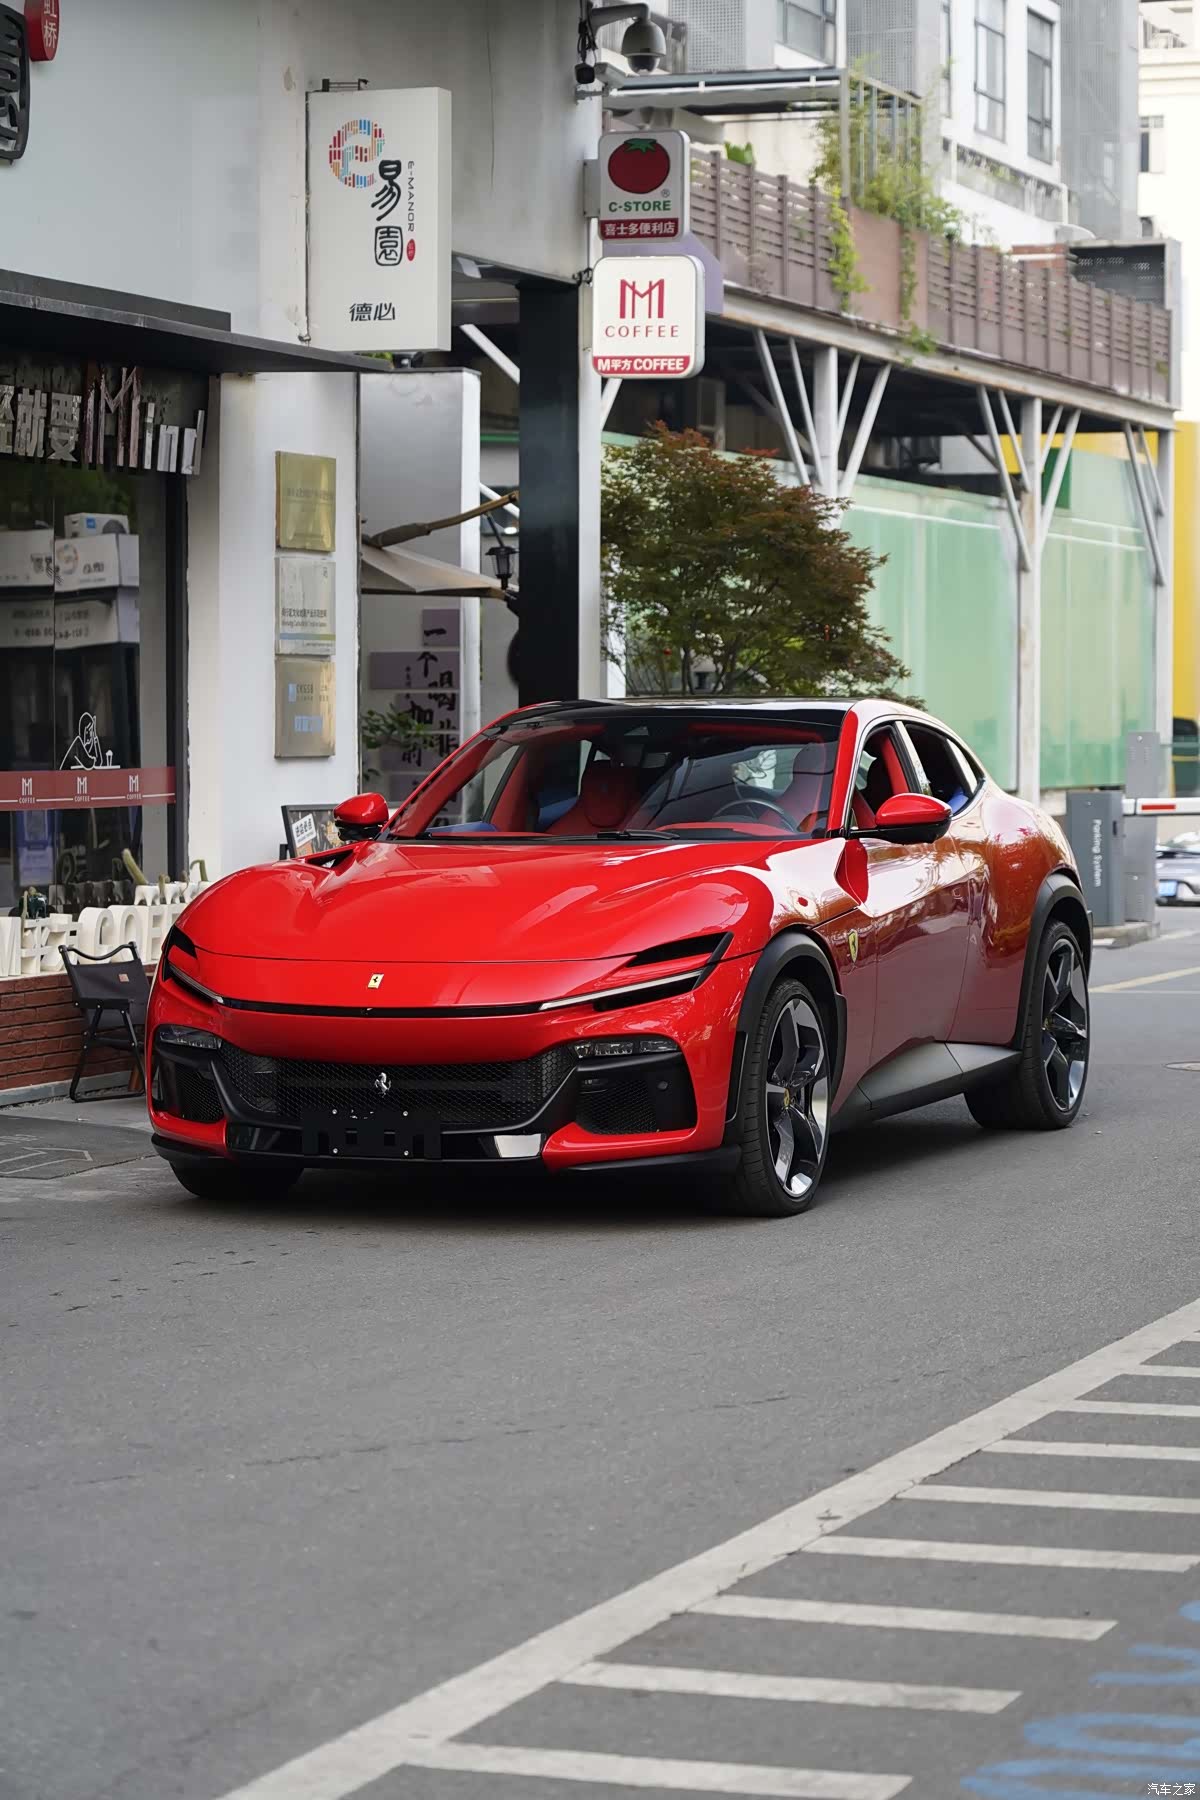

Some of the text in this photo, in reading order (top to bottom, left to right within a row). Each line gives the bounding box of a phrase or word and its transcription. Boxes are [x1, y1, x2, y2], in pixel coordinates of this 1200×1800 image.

[608, 200, 672, 213] C-STORE
[604, 221, 676, 236] 喜士多便利店
[349, 303, 396, 322] 德必
[605, 325, 679, 338] COFFEE
[74, 795, 91, 803] COFFEE
